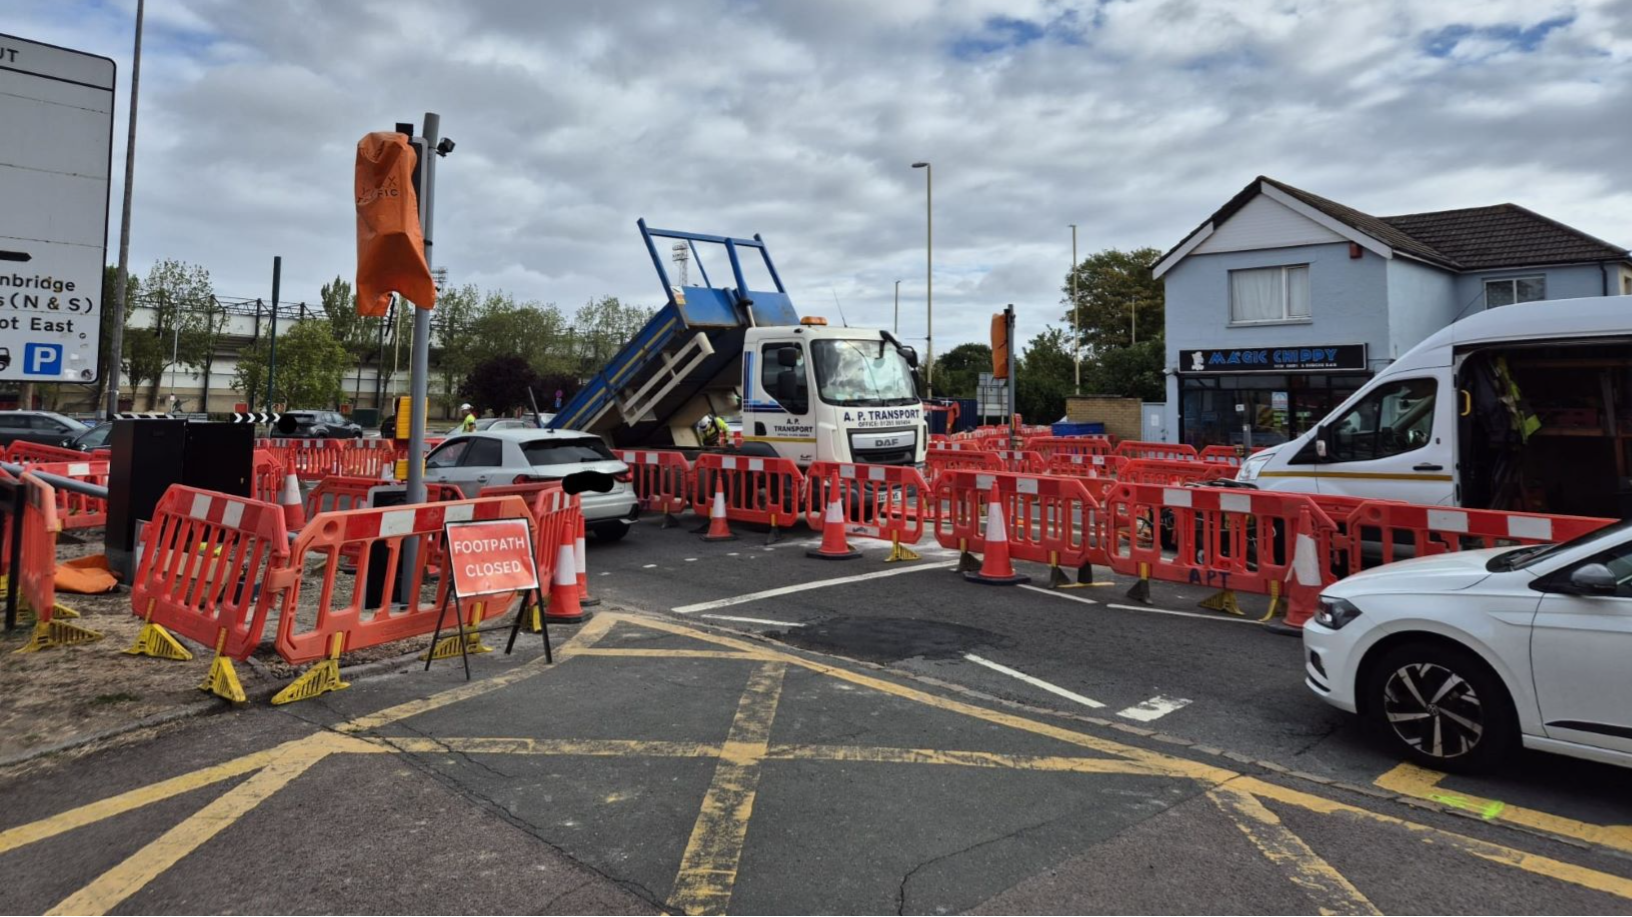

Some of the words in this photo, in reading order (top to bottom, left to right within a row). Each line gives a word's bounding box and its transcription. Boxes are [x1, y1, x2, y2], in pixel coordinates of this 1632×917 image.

[47, 296, 60, 310] &
[68, 297, 93, 314] S)
[30, 317, 74, 333] East
[33, 346, 57, 372] P
[1208, 350, 1268, 364] MAGIC
[1273, 348, 1338, 363] CHIPPY
[843, 411, 855, 422] A.
[857, 411, 866, 421] P.
[868, 409, 920, 420] TRANSPORT
[774, 425, 814, 433] TRANSPORT
[875, 438, 899, 447] DAF
[453, 537, 526, 554] FOOTPATH
[465, 560, 521, 577] CLOSED
[1189, 568, 1231, 589] APT
